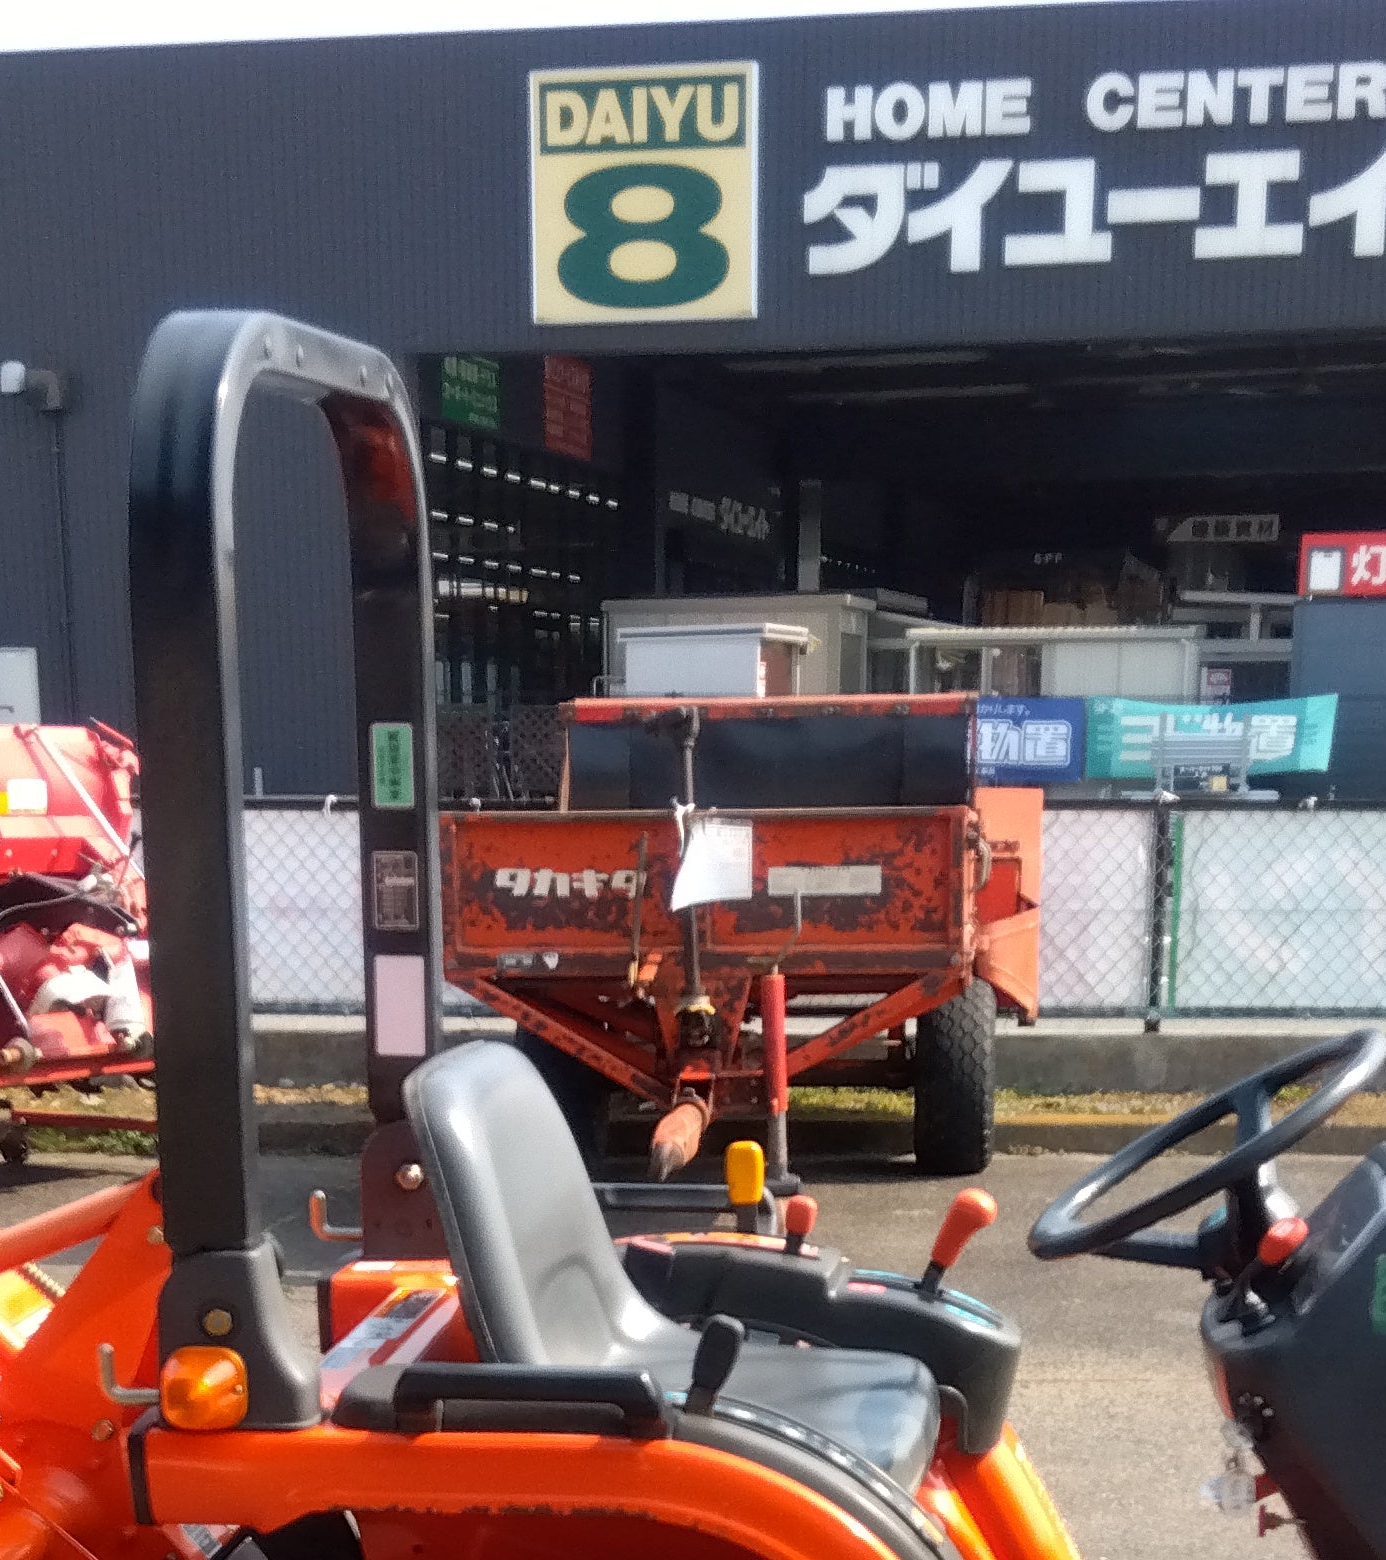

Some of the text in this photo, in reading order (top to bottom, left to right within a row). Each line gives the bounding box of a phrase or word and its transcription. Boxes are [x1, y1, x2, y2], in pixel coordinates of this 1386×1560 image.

[545, 82, 740, 146] DAIYU
[824, 78, 1033, 142] HOME
[556, 162, 731, 309] 8
